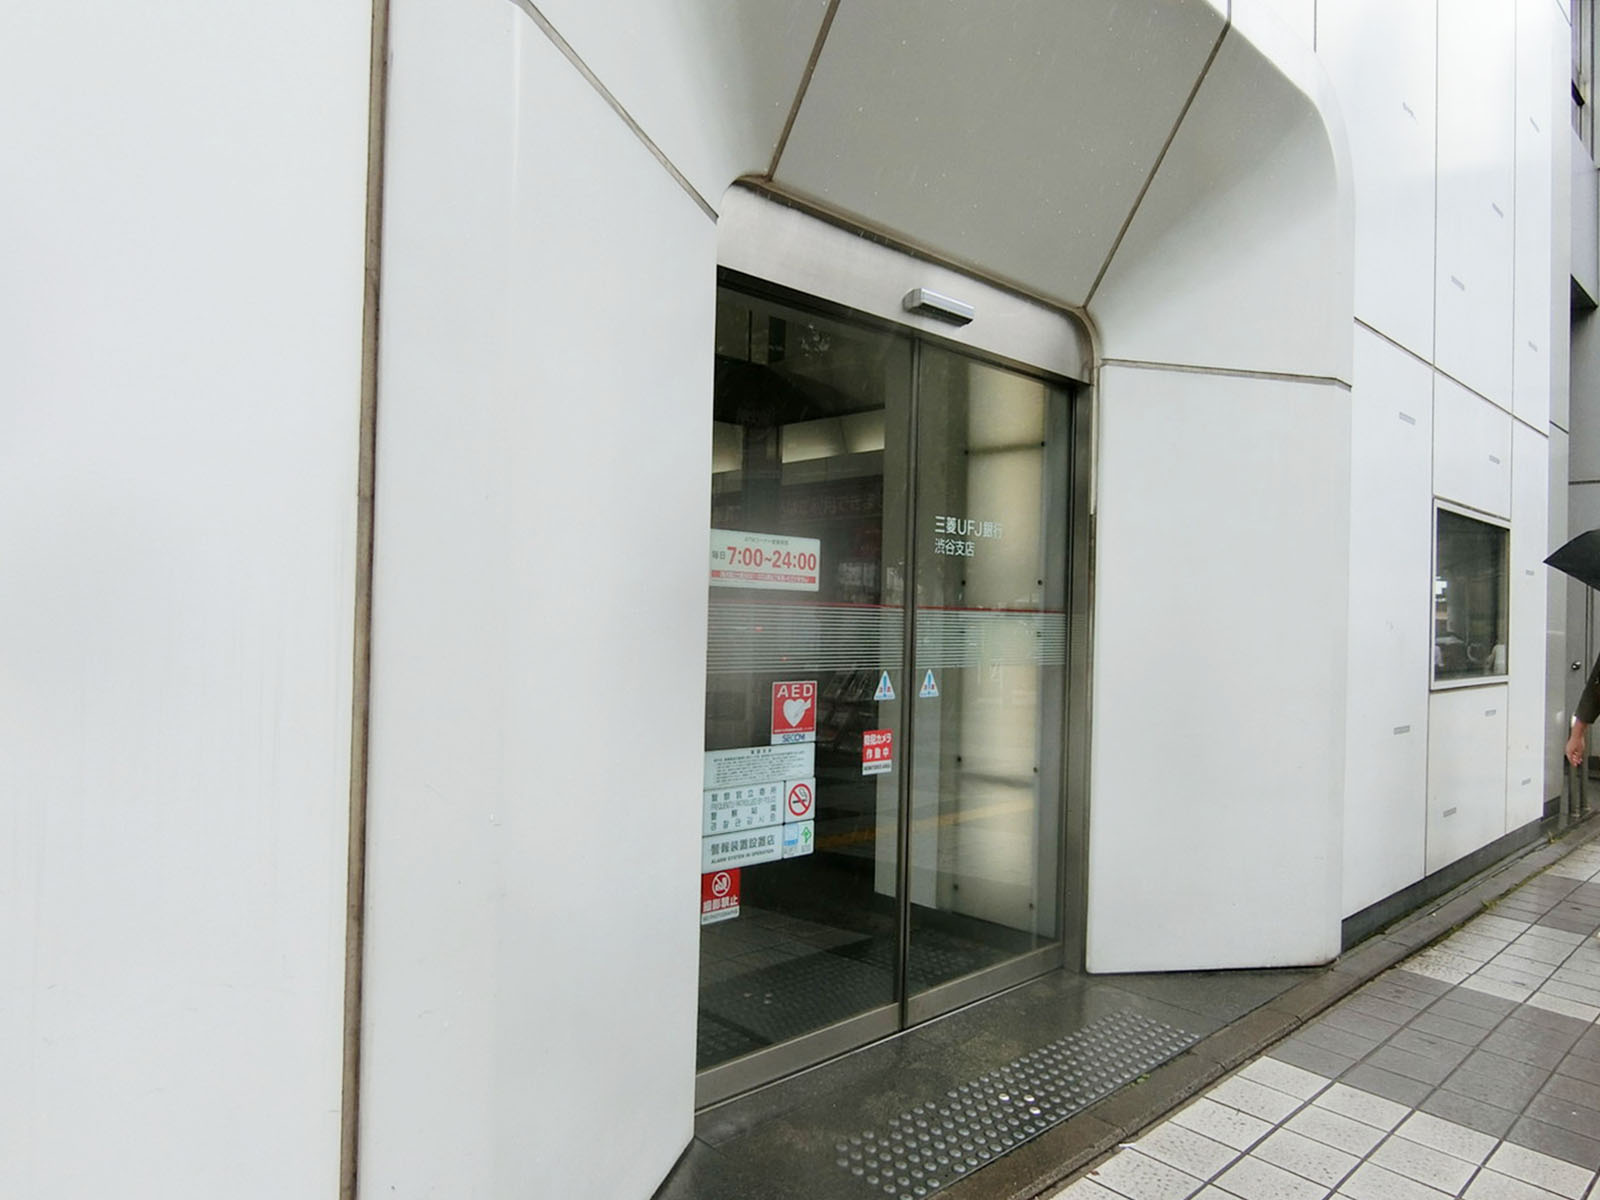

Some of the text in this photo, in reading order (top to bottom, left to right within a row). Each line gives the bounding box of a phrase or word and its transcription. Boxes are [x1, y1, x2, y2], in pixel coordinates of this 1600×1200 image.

[935, 515, 1004, 539] 三菱UFJ銀行
[935, 538, 975, 557] 渋谷支店
[776, 684, 813, 698] AED
[711, 835, 775, 856] 警報装置設置店
